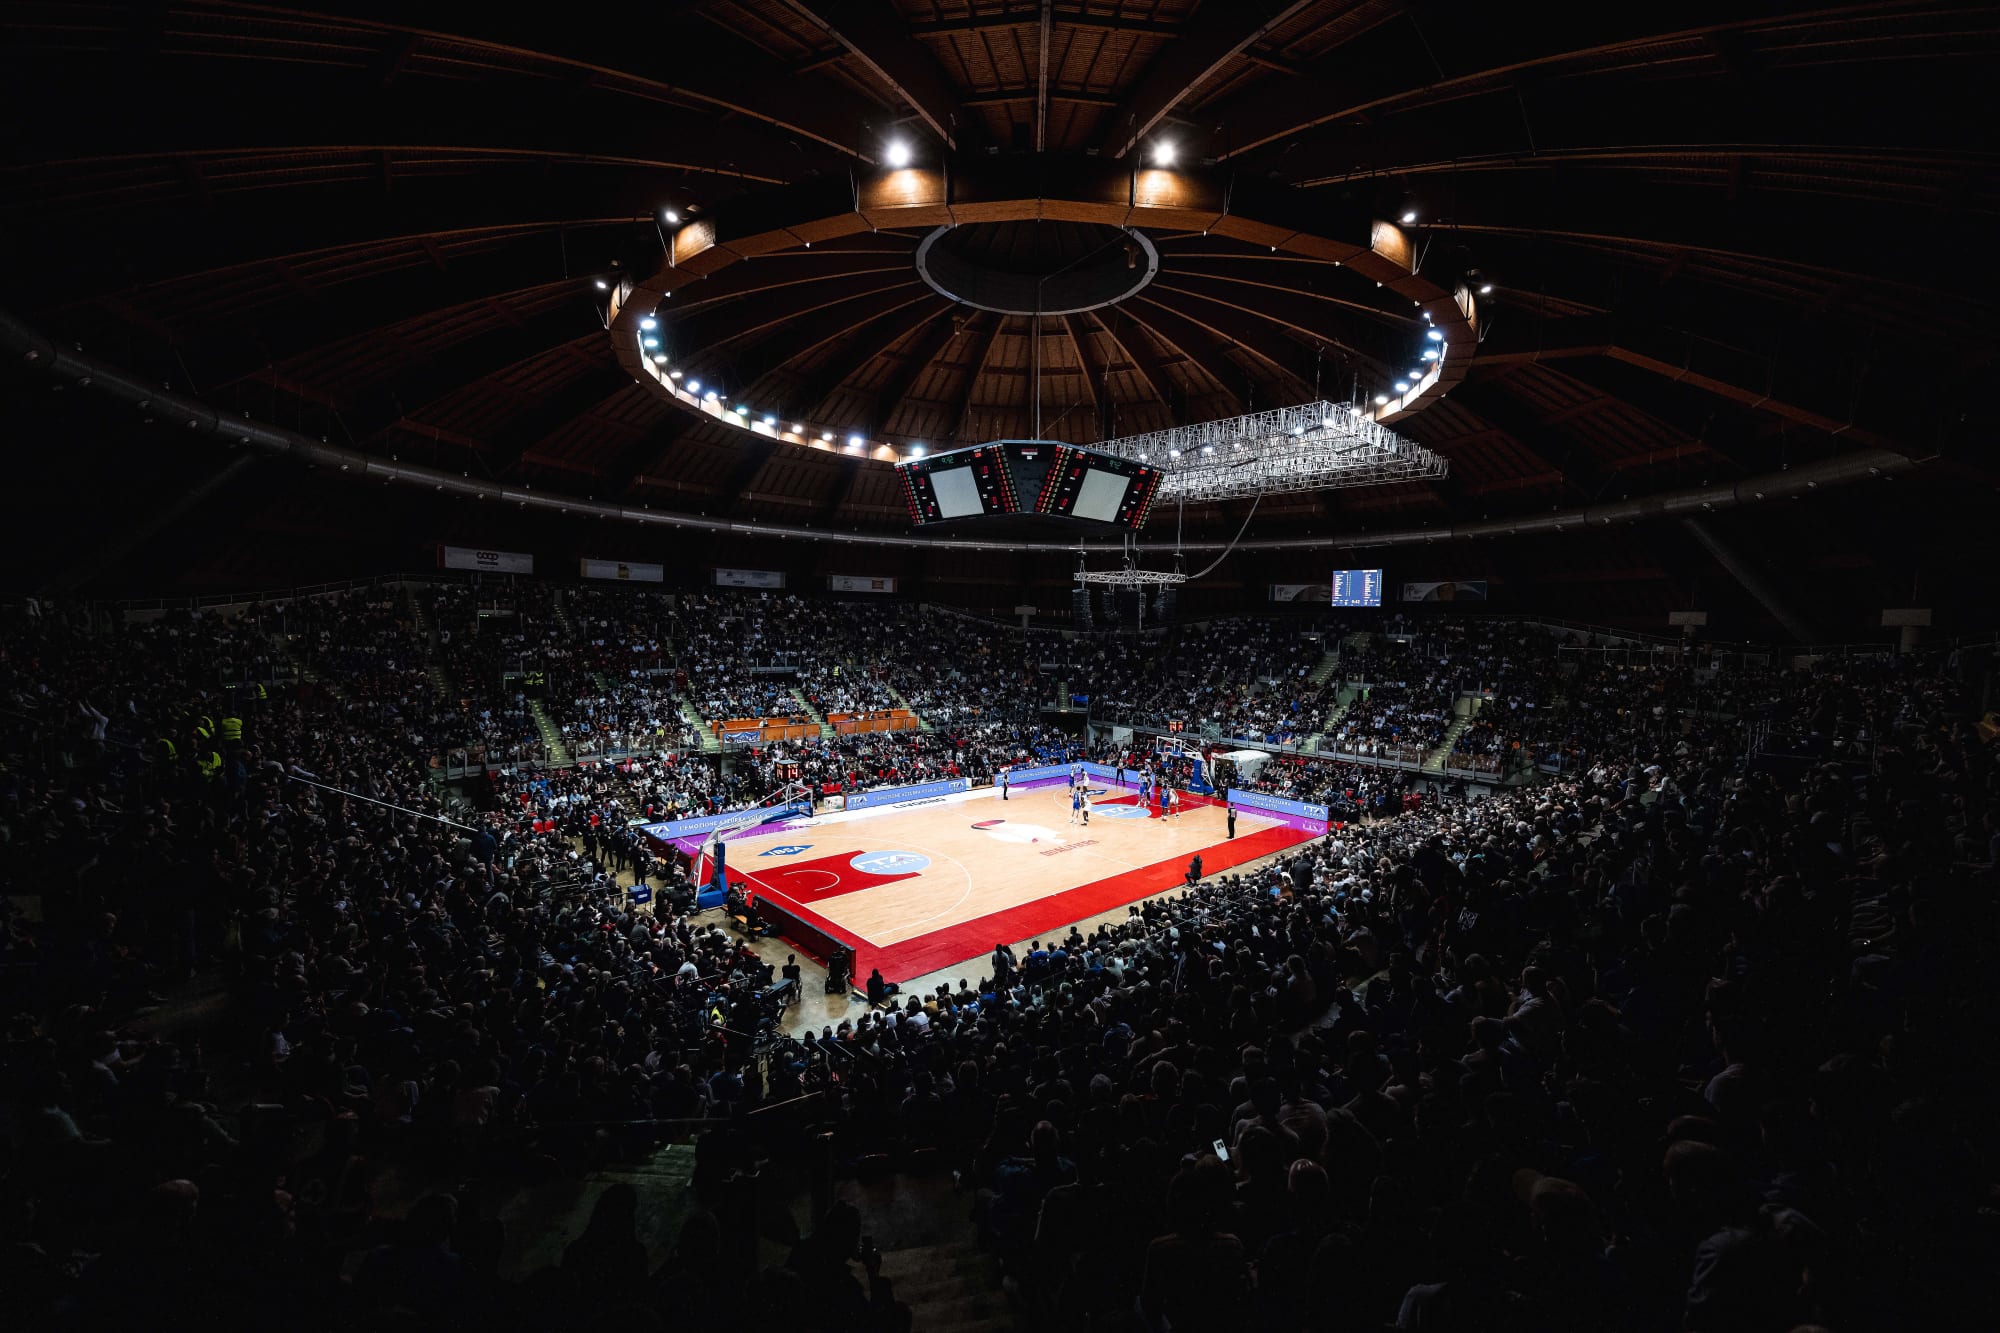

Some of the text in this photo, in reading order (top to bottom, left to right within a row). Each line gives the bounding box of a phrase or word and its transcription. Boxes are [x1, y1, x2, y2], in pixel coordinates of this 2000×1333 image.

[788, 768, 798, 779] 14
[848, 795, 868, 804] ITA
[1303, 805, 1326, 815] ITA
[767, 845, 806, 857] IBSA
